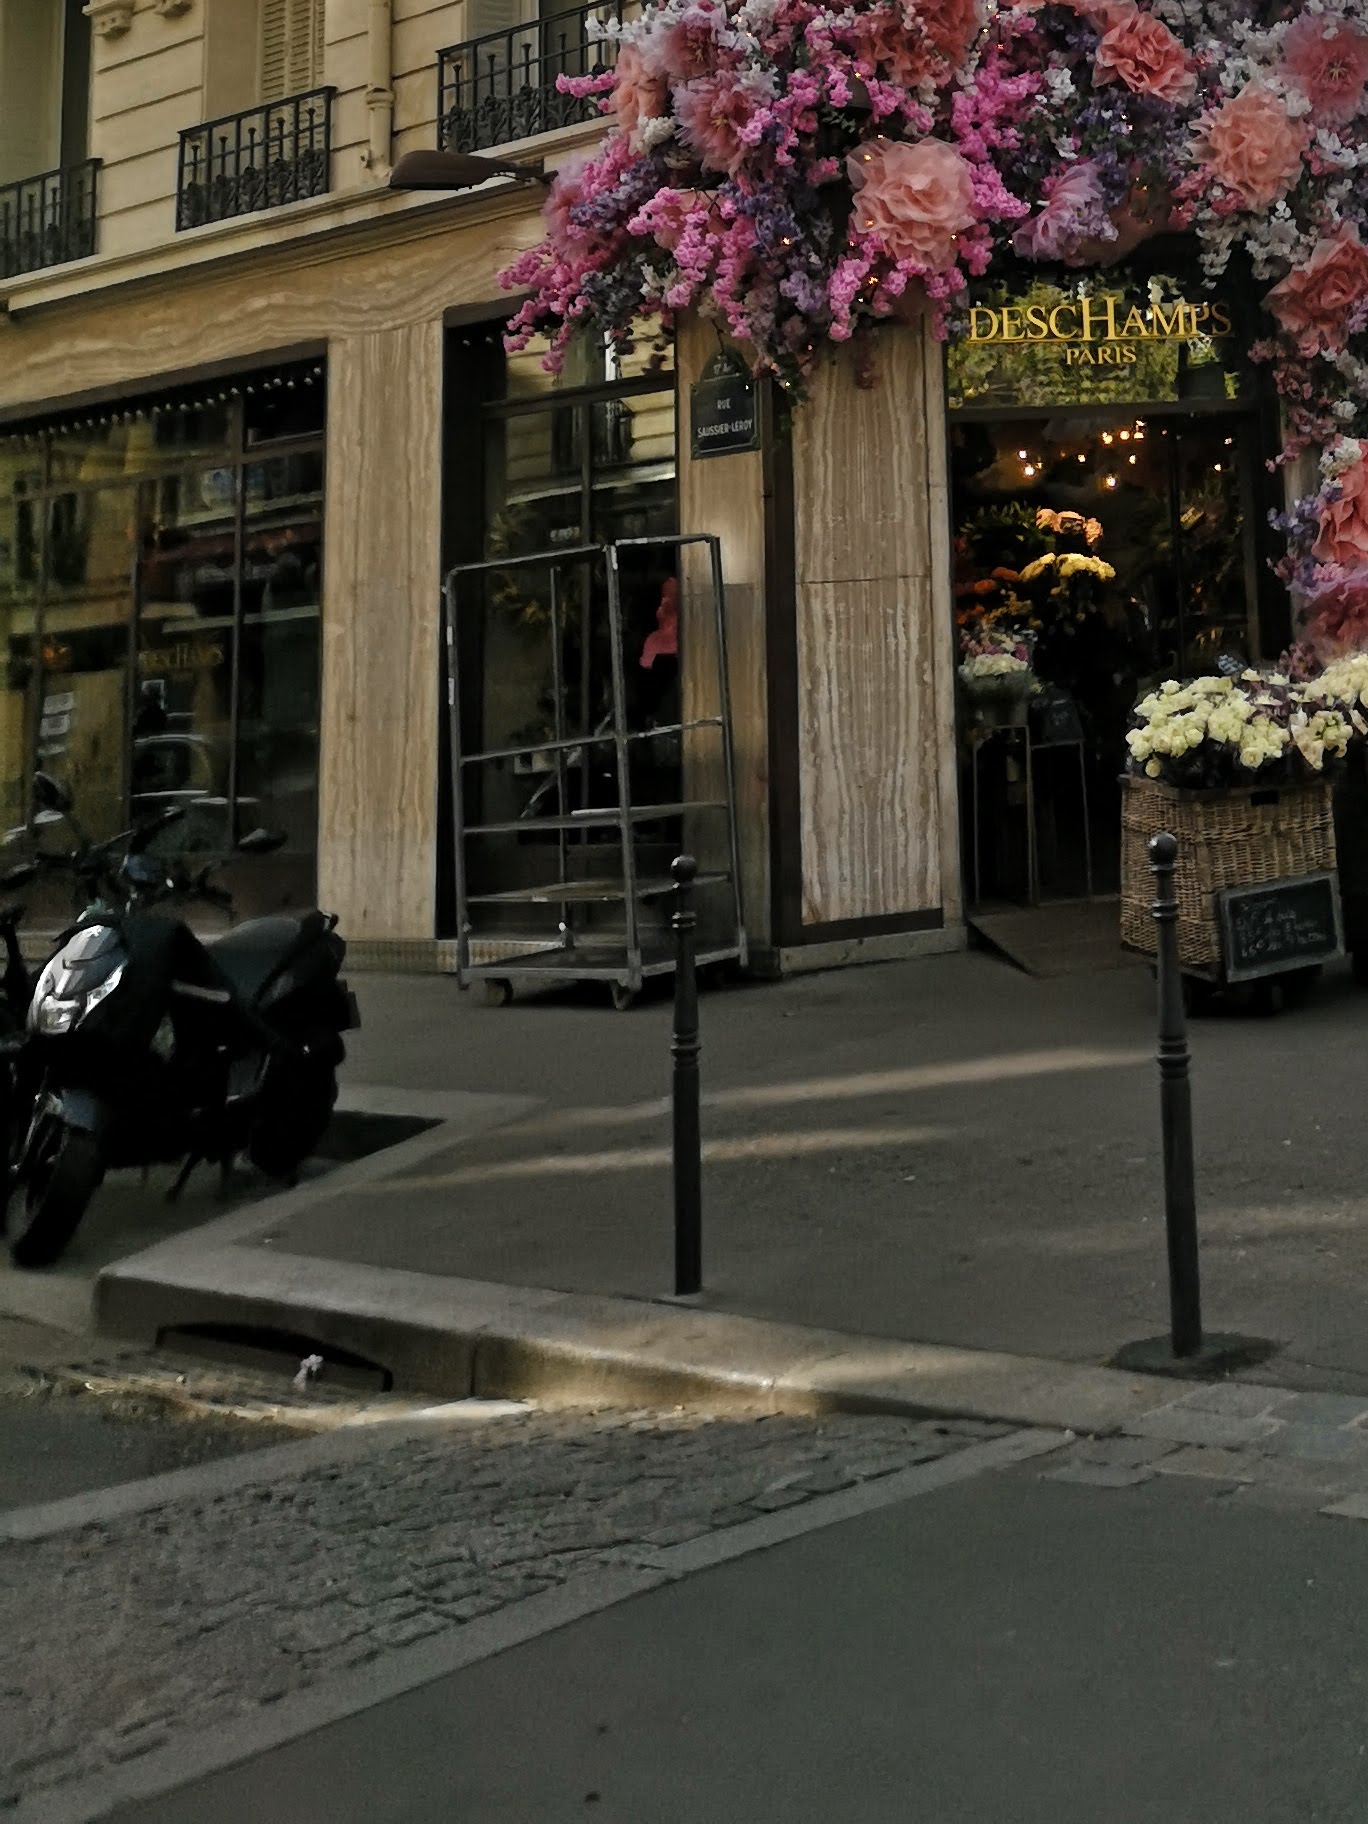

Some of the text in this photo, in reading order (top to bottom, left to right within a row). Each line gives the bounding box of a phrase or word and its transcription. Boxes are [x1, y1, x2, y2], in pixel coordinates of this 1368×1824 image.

[968, 296, 1232, 342] DESCHAMPS
[1065, 346, 1137, 365] PARIS
[717, 398, 731, 411] RUE
[697, 419, 753, 438] SAUSSIER-LEROY
